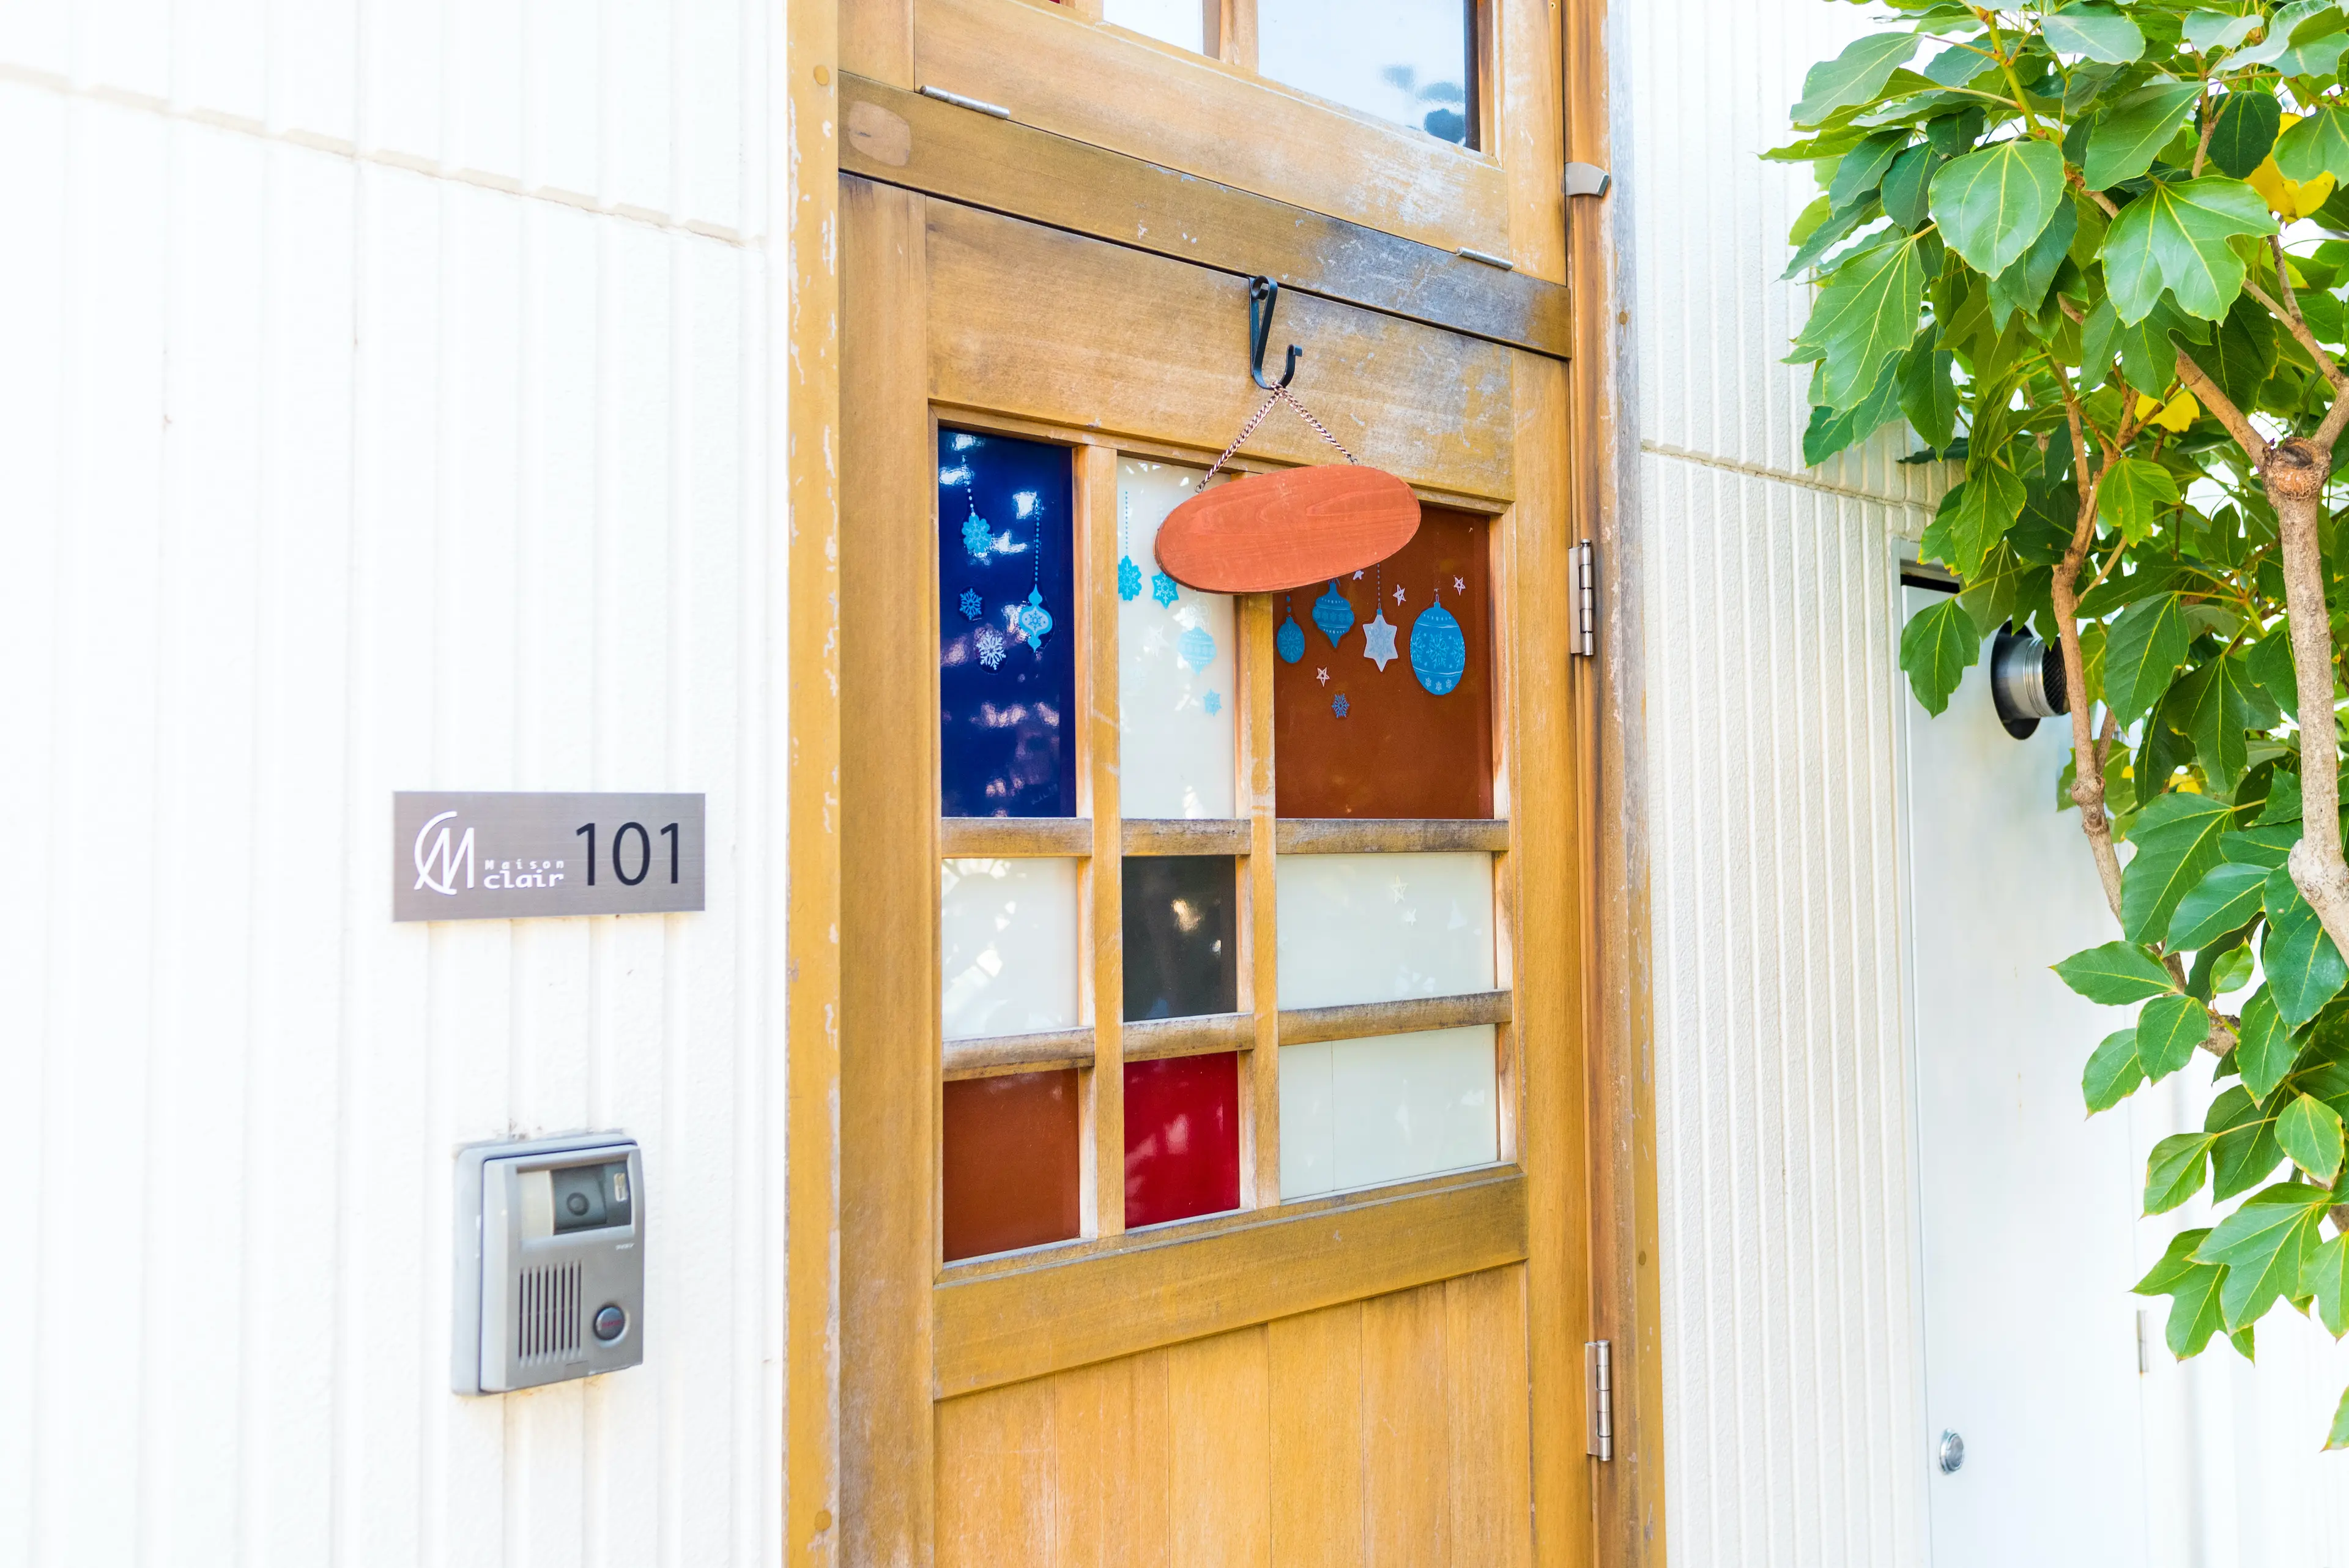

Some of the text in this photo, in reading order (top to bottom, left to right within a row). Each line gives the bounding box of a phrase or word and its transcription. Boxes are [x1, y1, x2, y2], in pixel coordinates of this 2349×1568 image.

[484, 858, 564, 870] Maison
[576, 822, 678, 886] 101
[483, 869, 564, 889] clair
